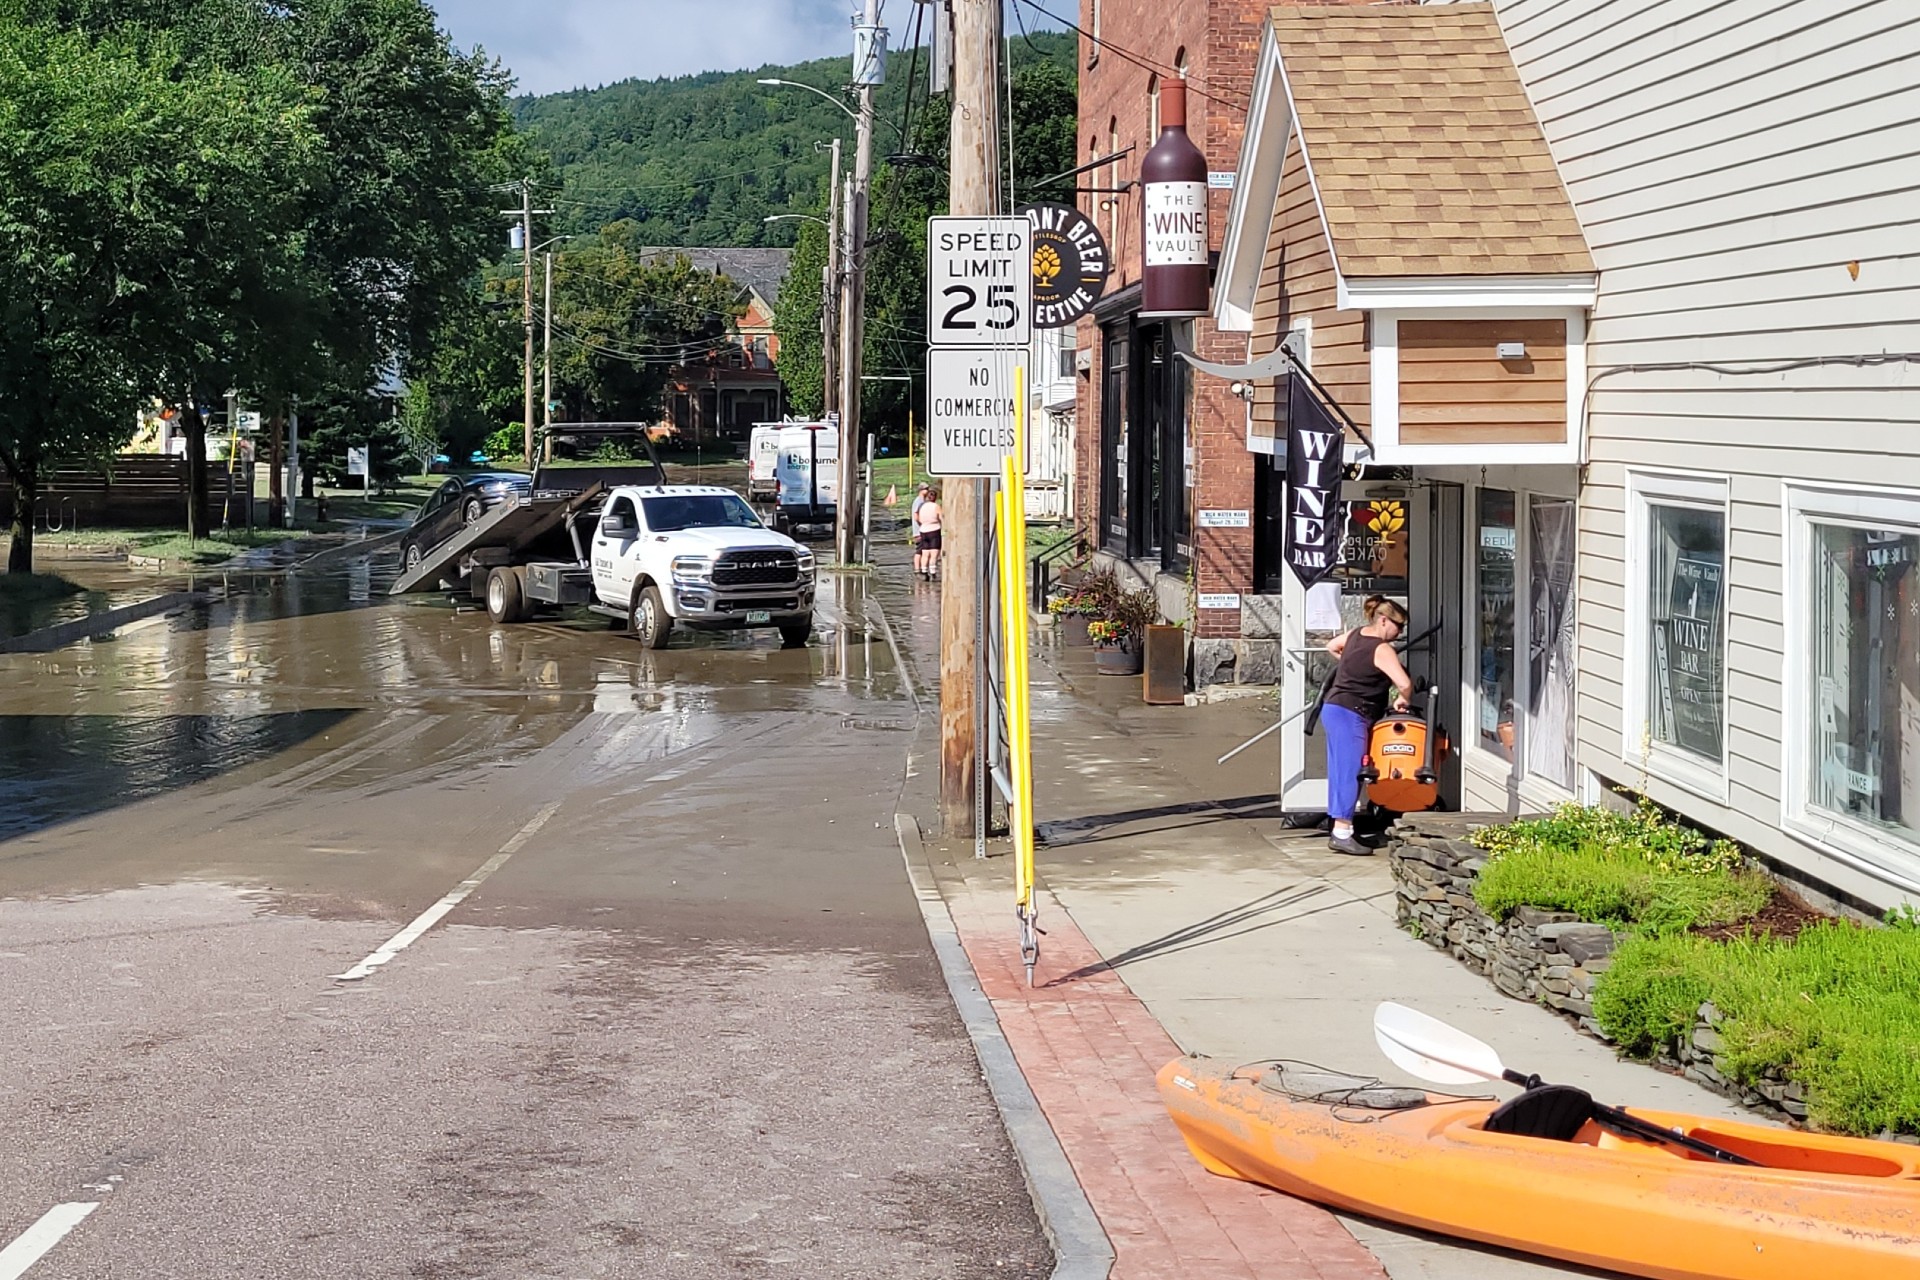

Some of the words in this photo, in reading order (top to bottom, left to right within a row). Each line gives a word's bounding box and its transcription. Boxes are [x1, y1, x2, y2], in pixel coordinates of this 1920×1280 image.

[1164, 195, 1193, 205] THE
[1153, 212, 1202, 234] WINE
[940, 233, 1021, 251] SPEED
[1066, 219, 1103, 273] BEER
[1155, 240, 1202, 251] VAULT
[949, 259, 1011, 277] LIMIT
[941, 284, 1020, 329] 25
[1035, 286, 1093, 323] ECTIVE
[969, 368, 989, 386] NO
[935, 398, 1023, 416] COMMERCIA
[944, 428, 1015, 447] VEHICLES
[1292, 428, 1335, 547] WINE
[1484, 536, 1507, 547] RED
[739, 561, 775, 569] RAM
[1293, 549, 1327, 568] BAR
[1674, 619, 1708, 652] WINE
[1680, 650, 1699, 674] BAR
